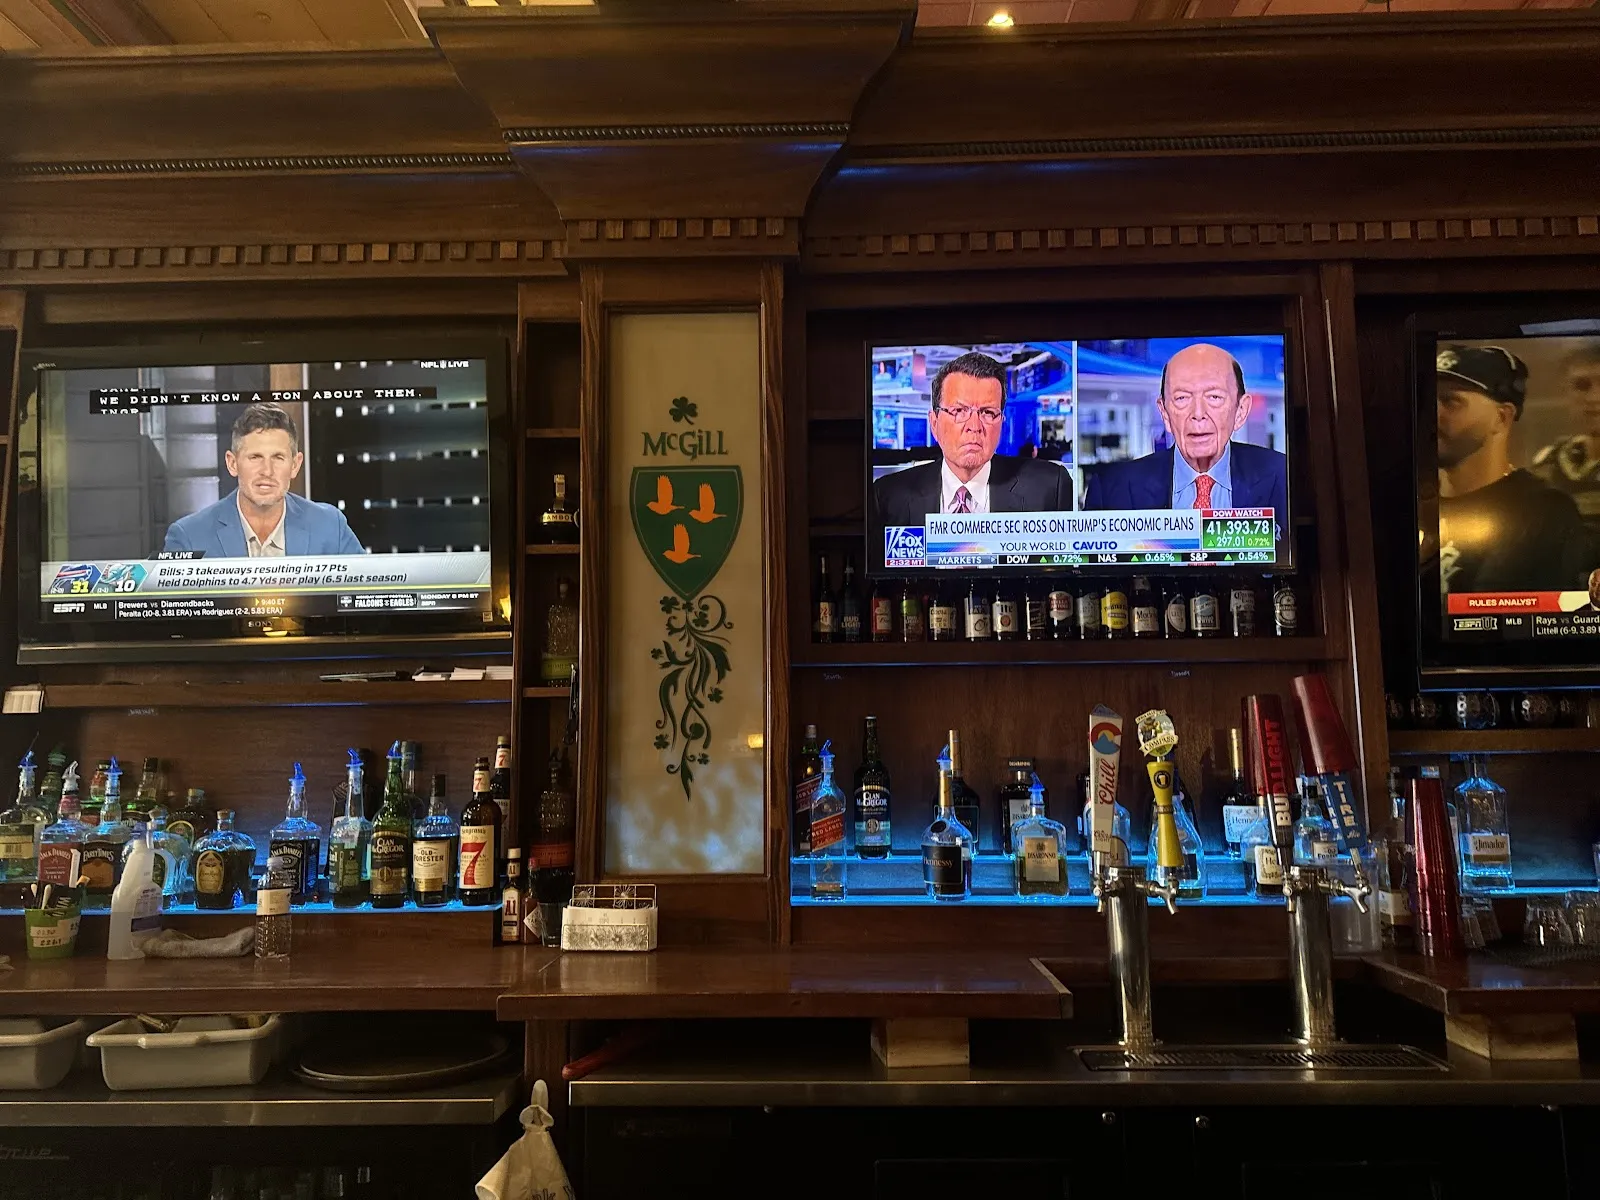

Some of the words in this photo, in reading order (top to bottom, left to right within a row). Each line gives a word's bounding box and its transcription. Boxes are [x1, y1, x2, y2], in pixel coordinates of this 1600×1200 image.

[420, 361, 440, 369] NFL
[448, 360, 469, 368] LIVE
[100, 397, 119, 405] WE
[130, 395, 191, 404] DIDN'T
[201, 393, 241, 402] KNOW
[252, 393, 261, 401] A
[272, 391, 301, 400] TON
[313, 390, 364, 399] ABOUT
[374, 389, 423, 398] THEM.
[1234, 509, 1263, 517] WATCH
[929, 521, 949, 535] FMR
[950, 520, 1002, 534] COMMERCE
[1004, 519, 1021, 533] SEC
[1023, 519, 1047, 533] ROSS
[1049, 519, 1065, 533] ON
[1067, 518, 1107, 532] TRUMP'S
[1109, 517, 1162, 532] ECONOMIC
[1164, 516, 1195, 531] PLANS
[1206, 519, 1270, 537] 41,393.78
[898, 535, 923, 547] FOX
[1000, 542, 1027, 551] YOUR
[1030, 541, 1067, 551] WORLD
[1072, 541, 1118, 551] CAVUTO
[1216, 536, 1245, 547] 297.01
[1247, 537, 1271, 546] 0.72%
[158, 552, 174, 560] NFL
[175, 551, 194, 559] LIVE
[891, 548, 924, 558] NEWS
[938, 556, 983, 565] MARKETS
[1006, 555, 1030, 564] DOW
[1053, 554, 1083, 564] 0.72%
[1097, 554, 1118, 563] NAS
[1144, 553, 1175, 562] 0.65%
[1190, 553, 1208, 562] S&P
[1238, 552, 1269, 561] 0.54%
[159, 567, 185, 576] Bills:
[195, 566, 253, 575] takeaways
[254, 564, 301, 575] resulting
[304, 564, 313, 573] in
[315, 564, 328, 573] 17
[329, 564, 348, 572] Pts
[115, 580, 136, 592] 10
[158, 579, 181, 587] Held
[182, 577, 226, 588] Dolphins
[228, 578, 240, 586] to
[241, 577, 257, 585] 4.7
[259, 576, 277, 585] Yds
[279, 577, 296, 587] per
[298, 575, 321, 585] play
[322, 574, 342, 584] (6.5
[344, 574, 364, 583] last
[366, 573, 408, 583] season)
[71, 580, 89, 593] 31
[53, 603, 86, 613] ESPN
[118, 601, 148, 609] Brewers
[161, 600, 214, 608] Diamondbacks
[354, 599, 384, 608] FALCONS
[389, 599, 415, 607] EAGLES
[1468, 598, 1497, 607] RULES
[1498, 598, 1538, 607] ANALYST
[118, 610, 142, 618] Peralta
[162, 609, 175, 617] 3.81
[175, 609, 193, 617] ERA)
[201, 608, 234, 619] Rodriguez
[251, 607, 265, 615] 5.83
[266, 606, 283, 615] ERA)
[248, 620, 274, 628] SONY
[1536, 615, 1557, 626] Rays
[1573, 615, 1600, 624] Guard
[1536, 626, 1558, 635] Littell
[1580, 626, 1597, 635] 3.89
[499, 754, 506, 767] 7
[474, 777, 483, 791] 7
[862, 791, 881, 800] CLAN
[376, 838, 395, 846] CLAN
[40, 848, 52, 860] JACK
[413, 854, 444, 862] FORESTER
[462, 840, 488, 886] 7
[923, 856, 954, 868] Hennessy
